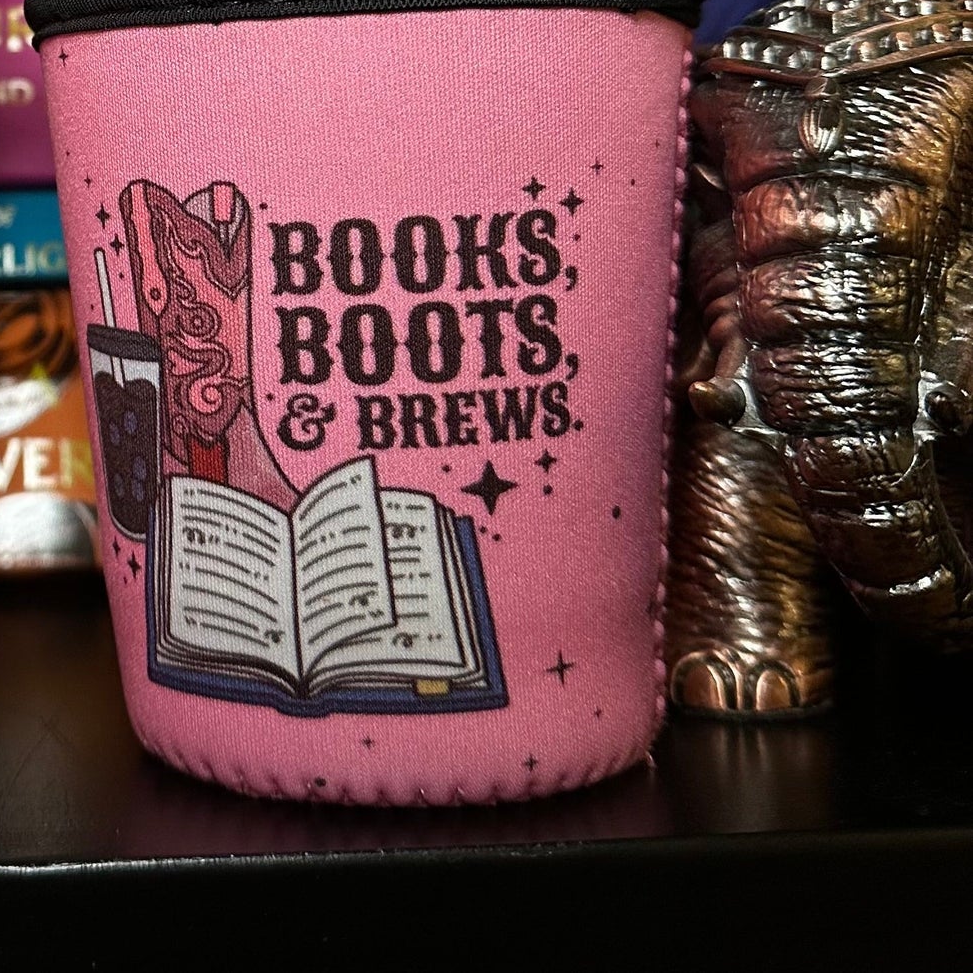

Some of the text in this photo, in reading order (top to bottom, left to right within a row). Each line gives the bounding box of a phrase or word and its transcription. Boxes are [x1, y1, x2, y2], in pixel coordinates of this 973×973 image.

[268, 208, 579, 297] BOOKS,
[276, 293, 580, 387] BOOTS,
[276, 381, 584, 452] & BREWS.
